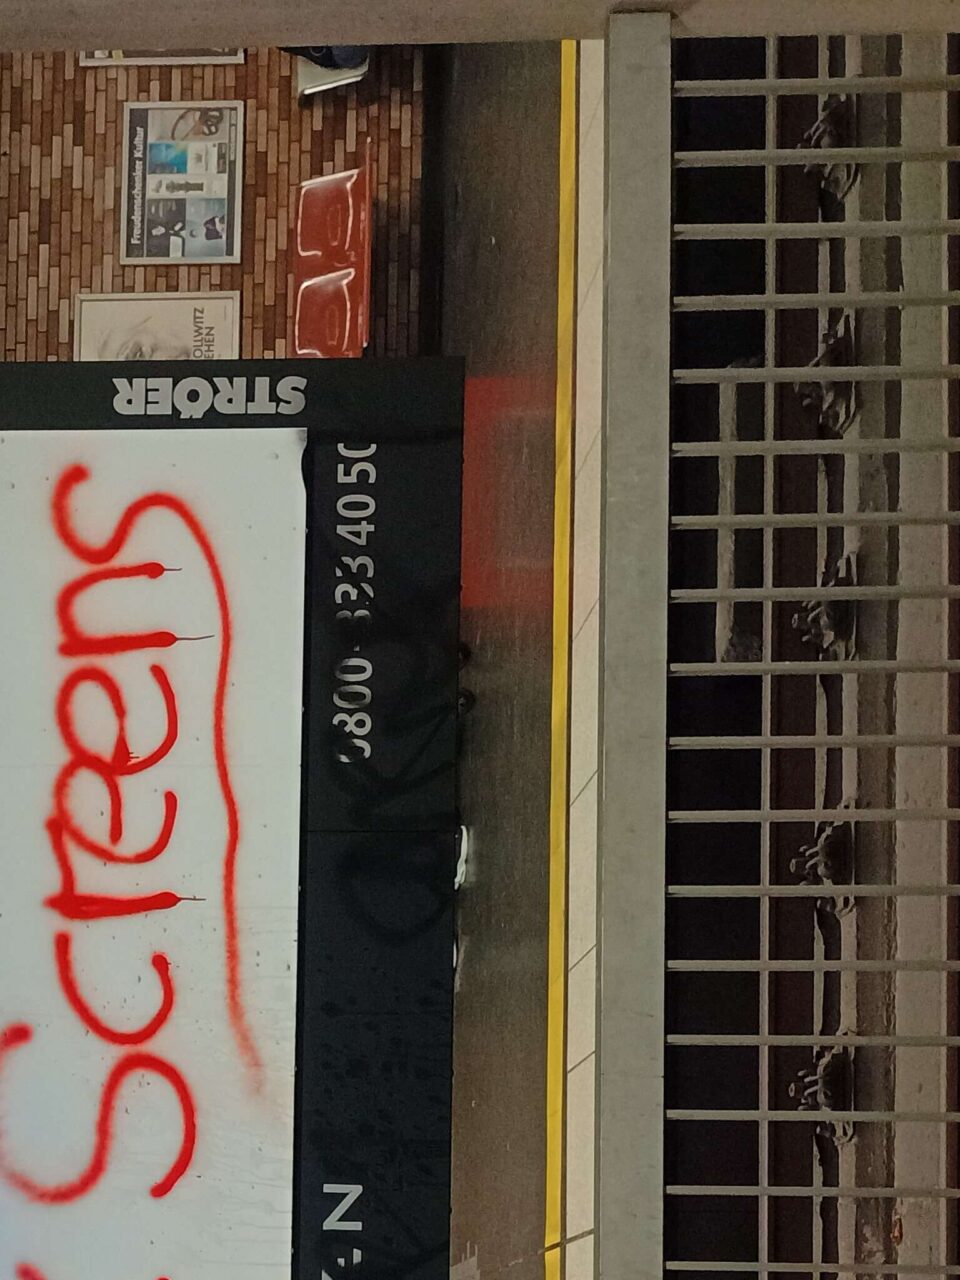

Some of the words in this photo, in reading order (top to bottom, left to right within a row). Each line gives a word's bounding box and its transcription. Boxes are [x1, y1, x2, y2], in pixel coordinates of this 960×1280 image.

[133, 126, 144, 158] Kultur
[112, 374, 308, 418] STRÖER
[336, 492, 376, 546] 40
